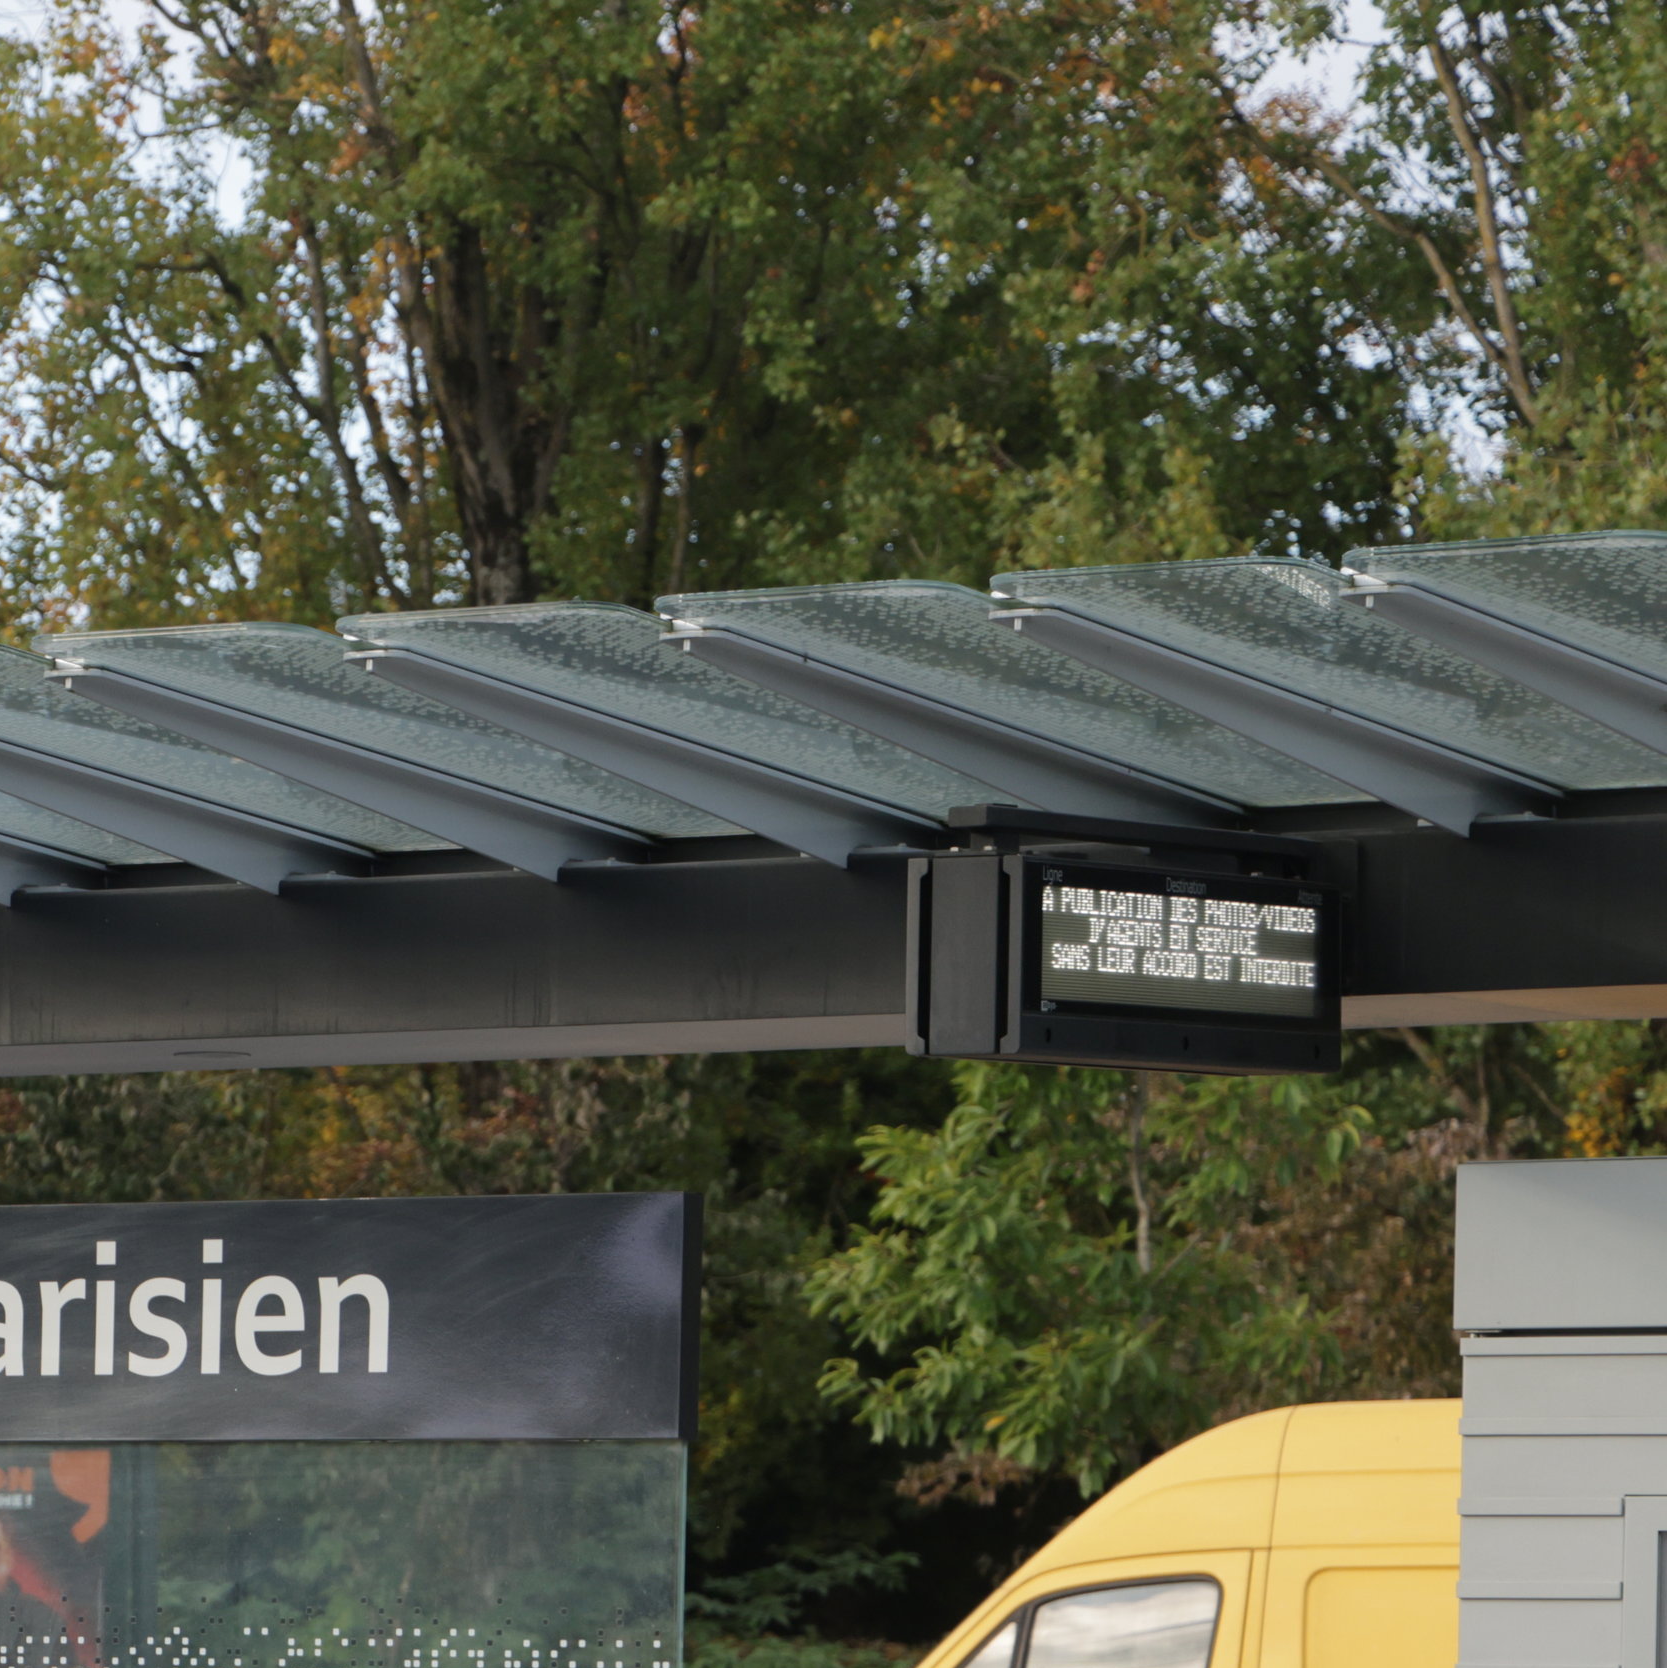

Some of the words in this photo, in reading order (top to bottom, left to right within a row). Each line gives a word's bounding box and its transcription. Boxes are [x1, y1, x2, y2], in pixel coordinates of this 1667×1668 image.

[1042, 865, 1064, 884] Ligne
[1166, 877, 1207, 895] Destination
[1060, 886, 1163, 920] PUBLICATION
[1169, 896, 1198, 923] DES
[1169, 924, 1188, 950] EN
[1196, 926, 1257, 955] SERVICE
[1051, 943, 1091, 970] SANS
[1098, 946, 1136, 974] LEUR
[1142, 950, 1197, 978] ACCORD
[1204, 954, 1231, 981] EST
[1240, 957, 1316, 988] INTERDITE
